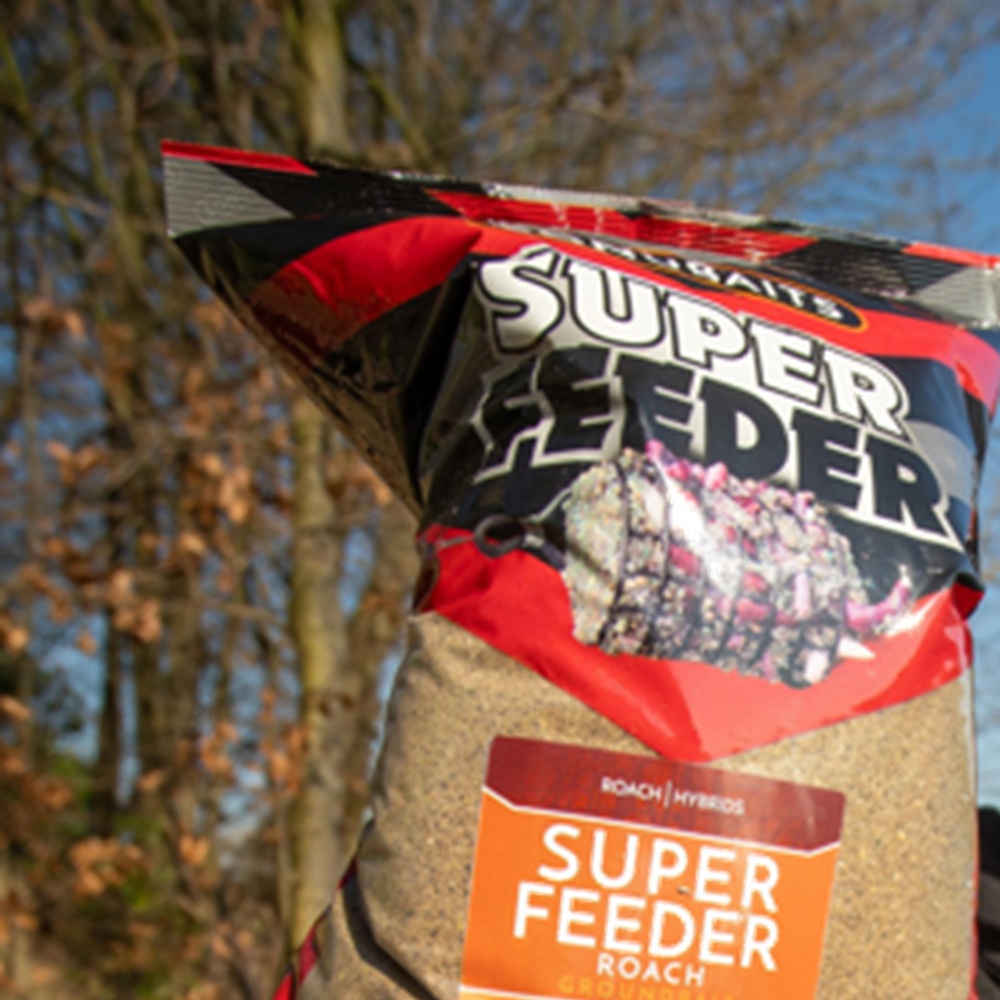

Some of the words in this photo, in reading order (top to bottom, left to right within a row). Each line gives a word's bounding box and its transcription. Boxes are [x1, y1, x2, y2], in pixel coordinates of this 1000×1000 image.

[478, 243, 908, 436] SUPER
[473, 345, 960, 545] FEEDER
[601, 776, 662, 802] ROACH
[673, 789, 745, 816] HYBRIDS
[537, 823, 779, 914] SUPER
[513, 881, 779, 971] FEEDER
[596, 953, 706, 986] ROACH
